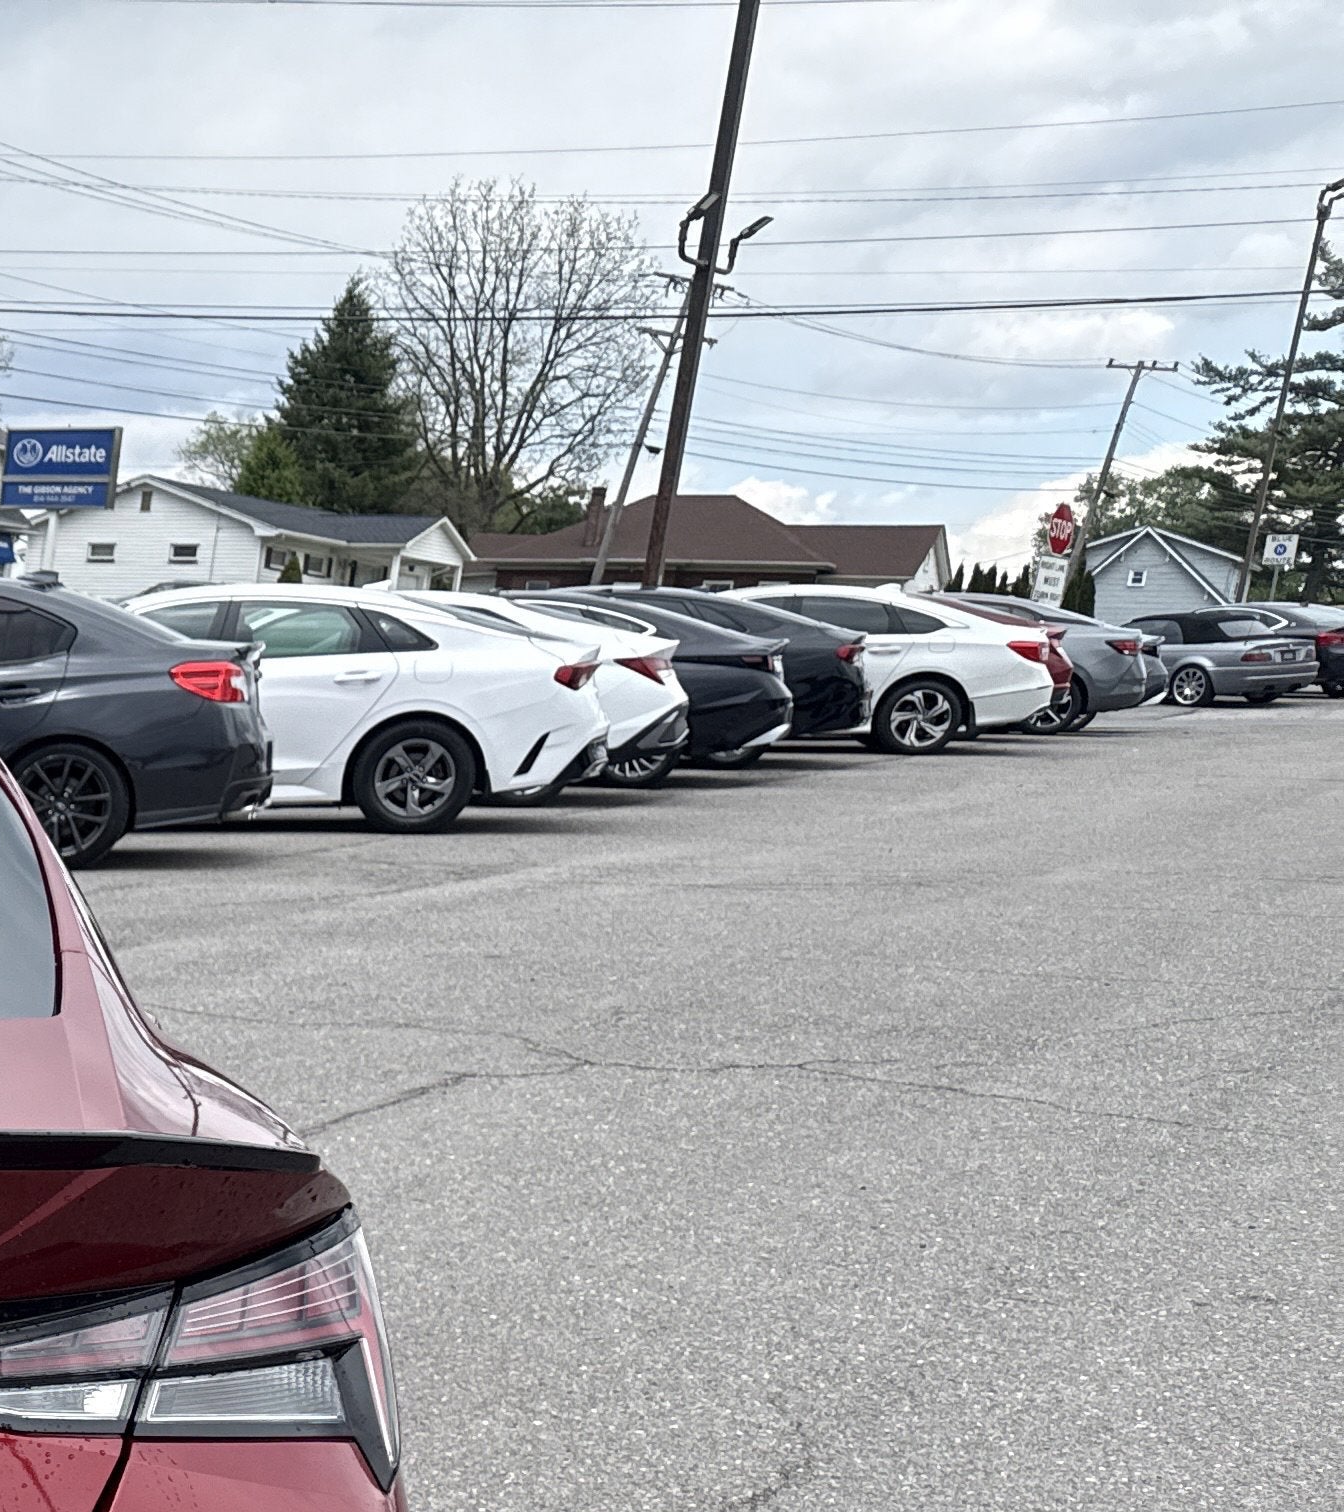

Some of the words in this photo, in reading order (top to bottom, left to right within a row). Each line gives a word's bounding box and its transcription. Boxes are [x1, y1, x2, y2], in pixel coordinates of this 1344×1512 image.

[43, 444, 106, 463] Allstate
[18, 485, 32, 494] THE
[62, 485, 93, 494] AGENCY
[1050, 518, 1073, 540] STOP
